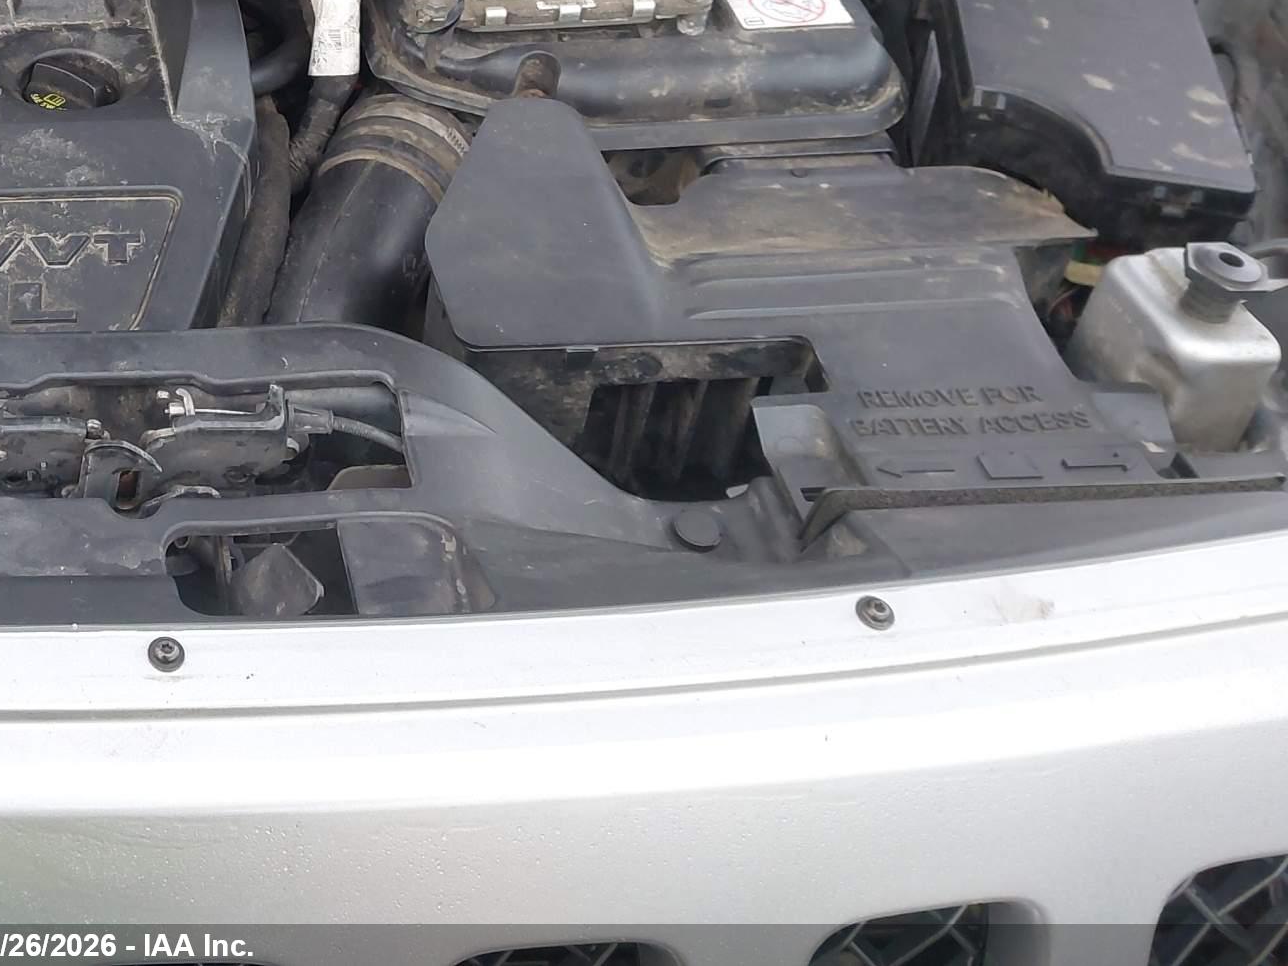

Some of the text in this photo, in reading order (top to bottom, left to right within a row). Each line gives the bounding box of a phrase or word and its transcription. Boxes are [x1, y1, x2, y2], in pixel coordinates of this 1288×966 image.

[856, 385, 1045, 409] REMOVE FOR
[849, 410, 1093, 436] BATTERY ACCESS
